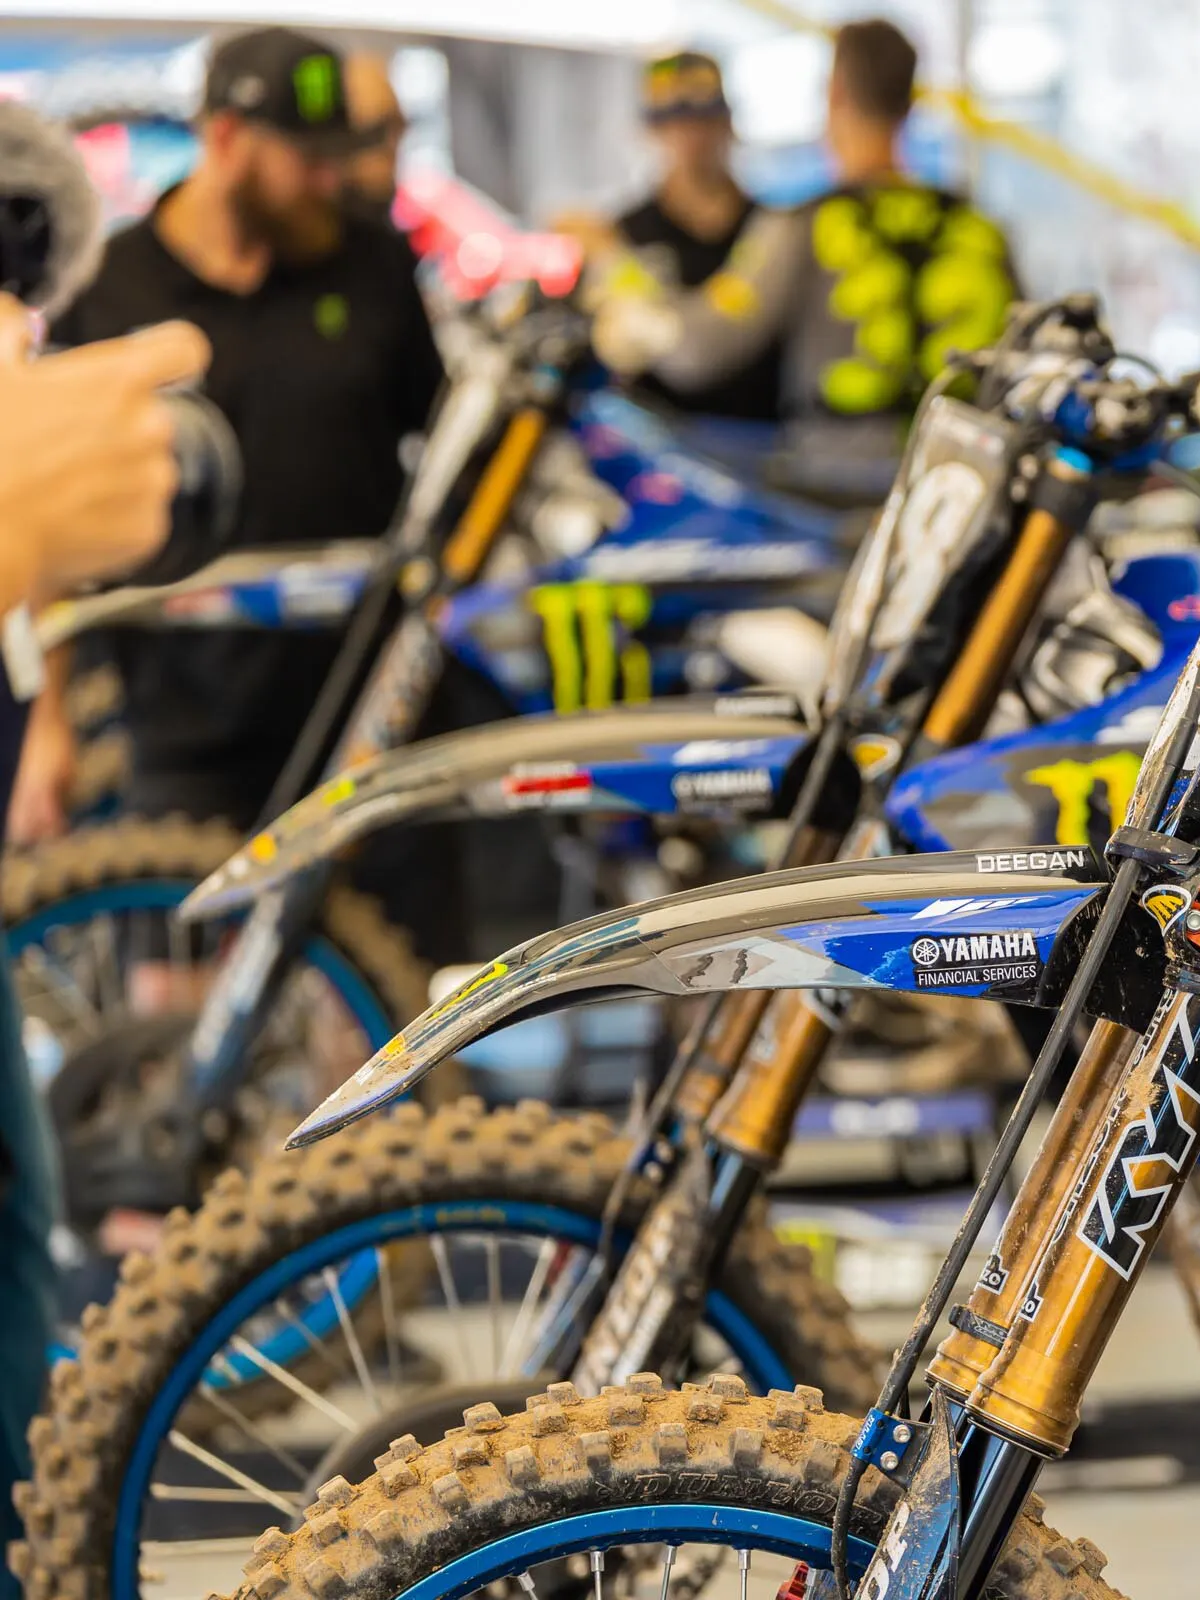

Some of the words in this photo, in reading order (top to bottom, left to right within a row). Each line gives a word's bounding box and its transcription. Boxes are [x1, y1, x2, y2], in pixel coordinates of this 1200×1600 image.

[977, 850, 1085, 873] DEEGAN
[940, 932, 1037, 962] YAMAHA
[918, 969, 980, 986] FINANCIAL
[982, 965, 1037, 982] SERVICES
